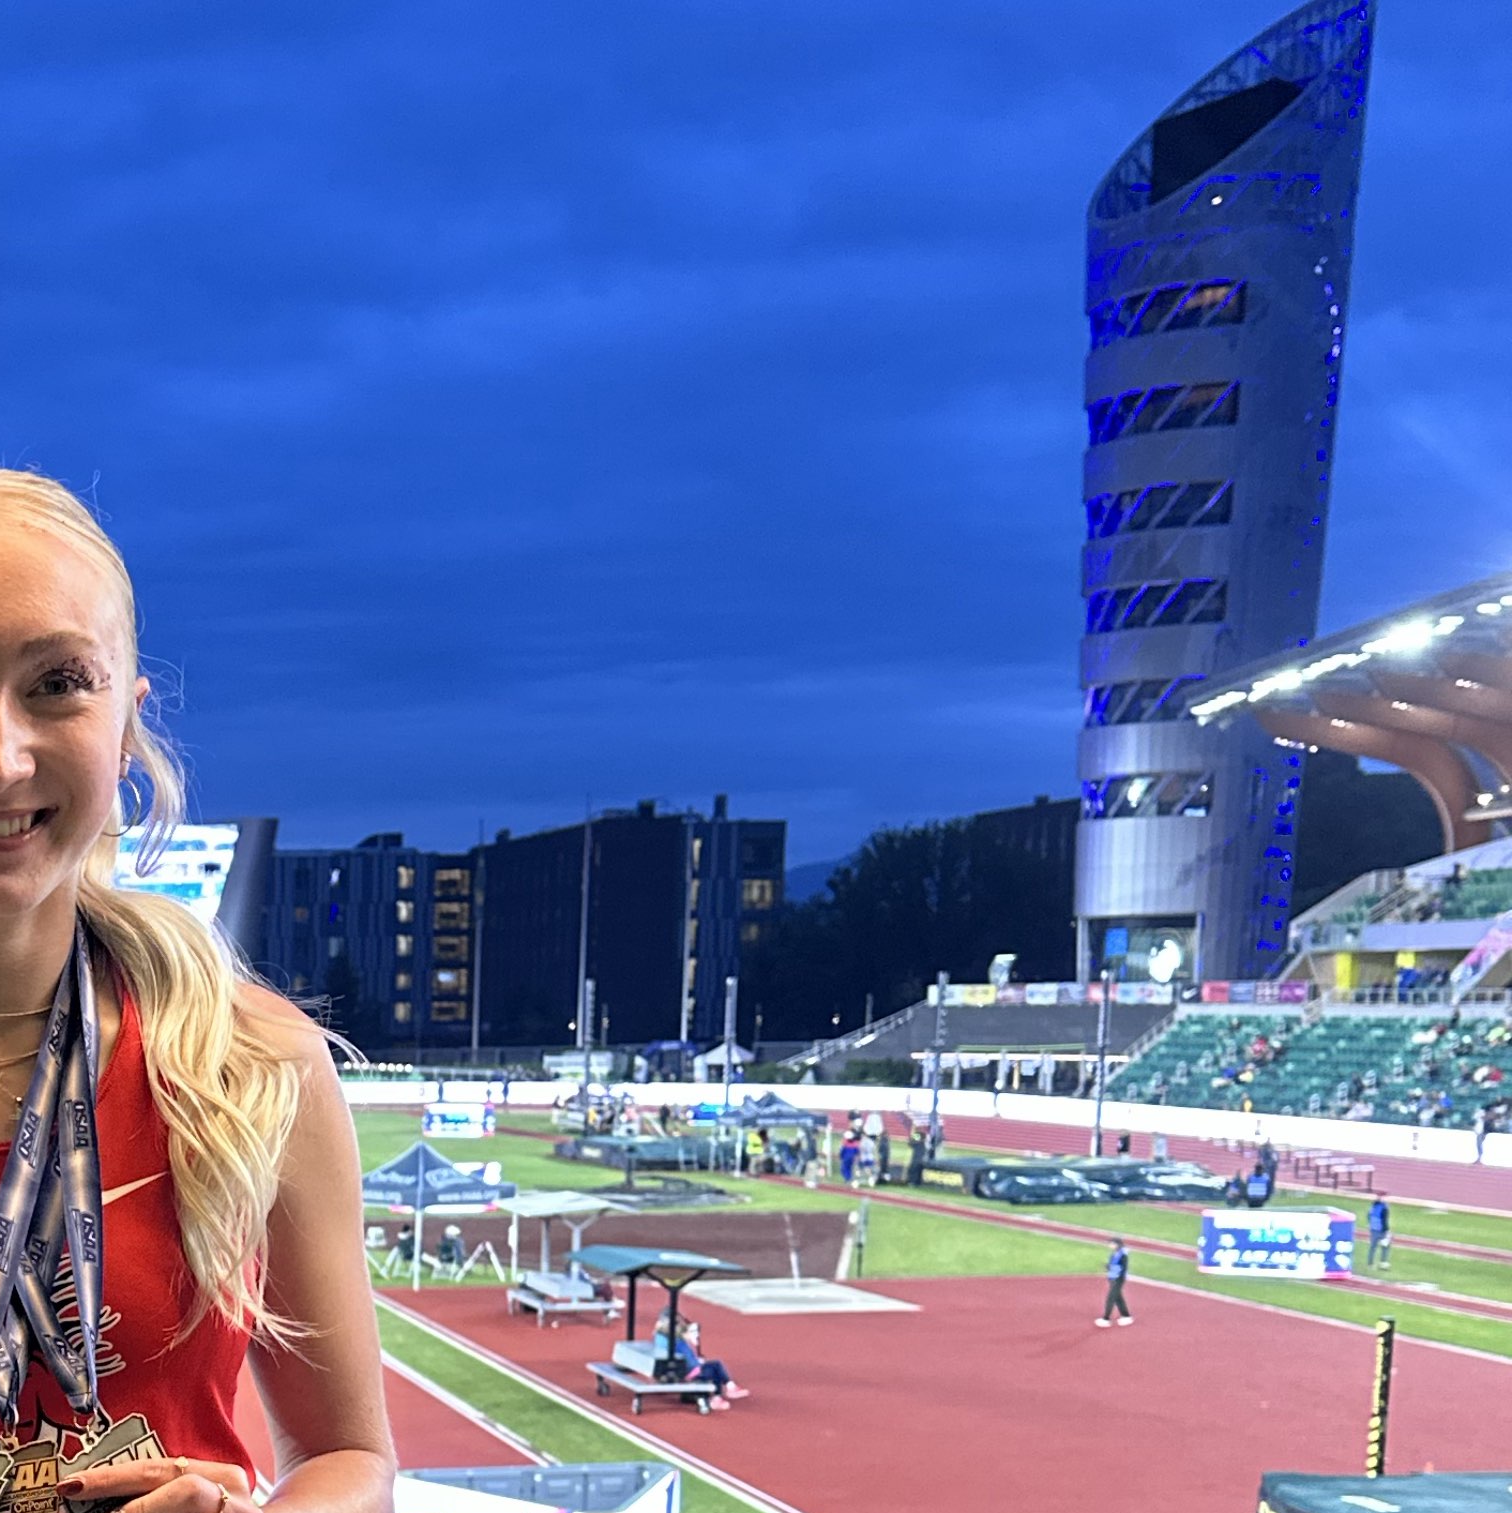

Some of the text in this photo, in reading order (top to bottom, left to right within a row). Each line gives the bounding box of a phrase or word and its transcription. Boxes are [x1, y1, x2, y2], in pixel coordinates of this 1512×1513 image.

[18, 1112, 40, 1159] OSAA
[74, 1100, 90, 1149] OSAA
[81, 1213, 97, 1263] OSAA
[10, 1459, 58, 1493] AA
[14, 1497, 54, 1513] OnPoint
